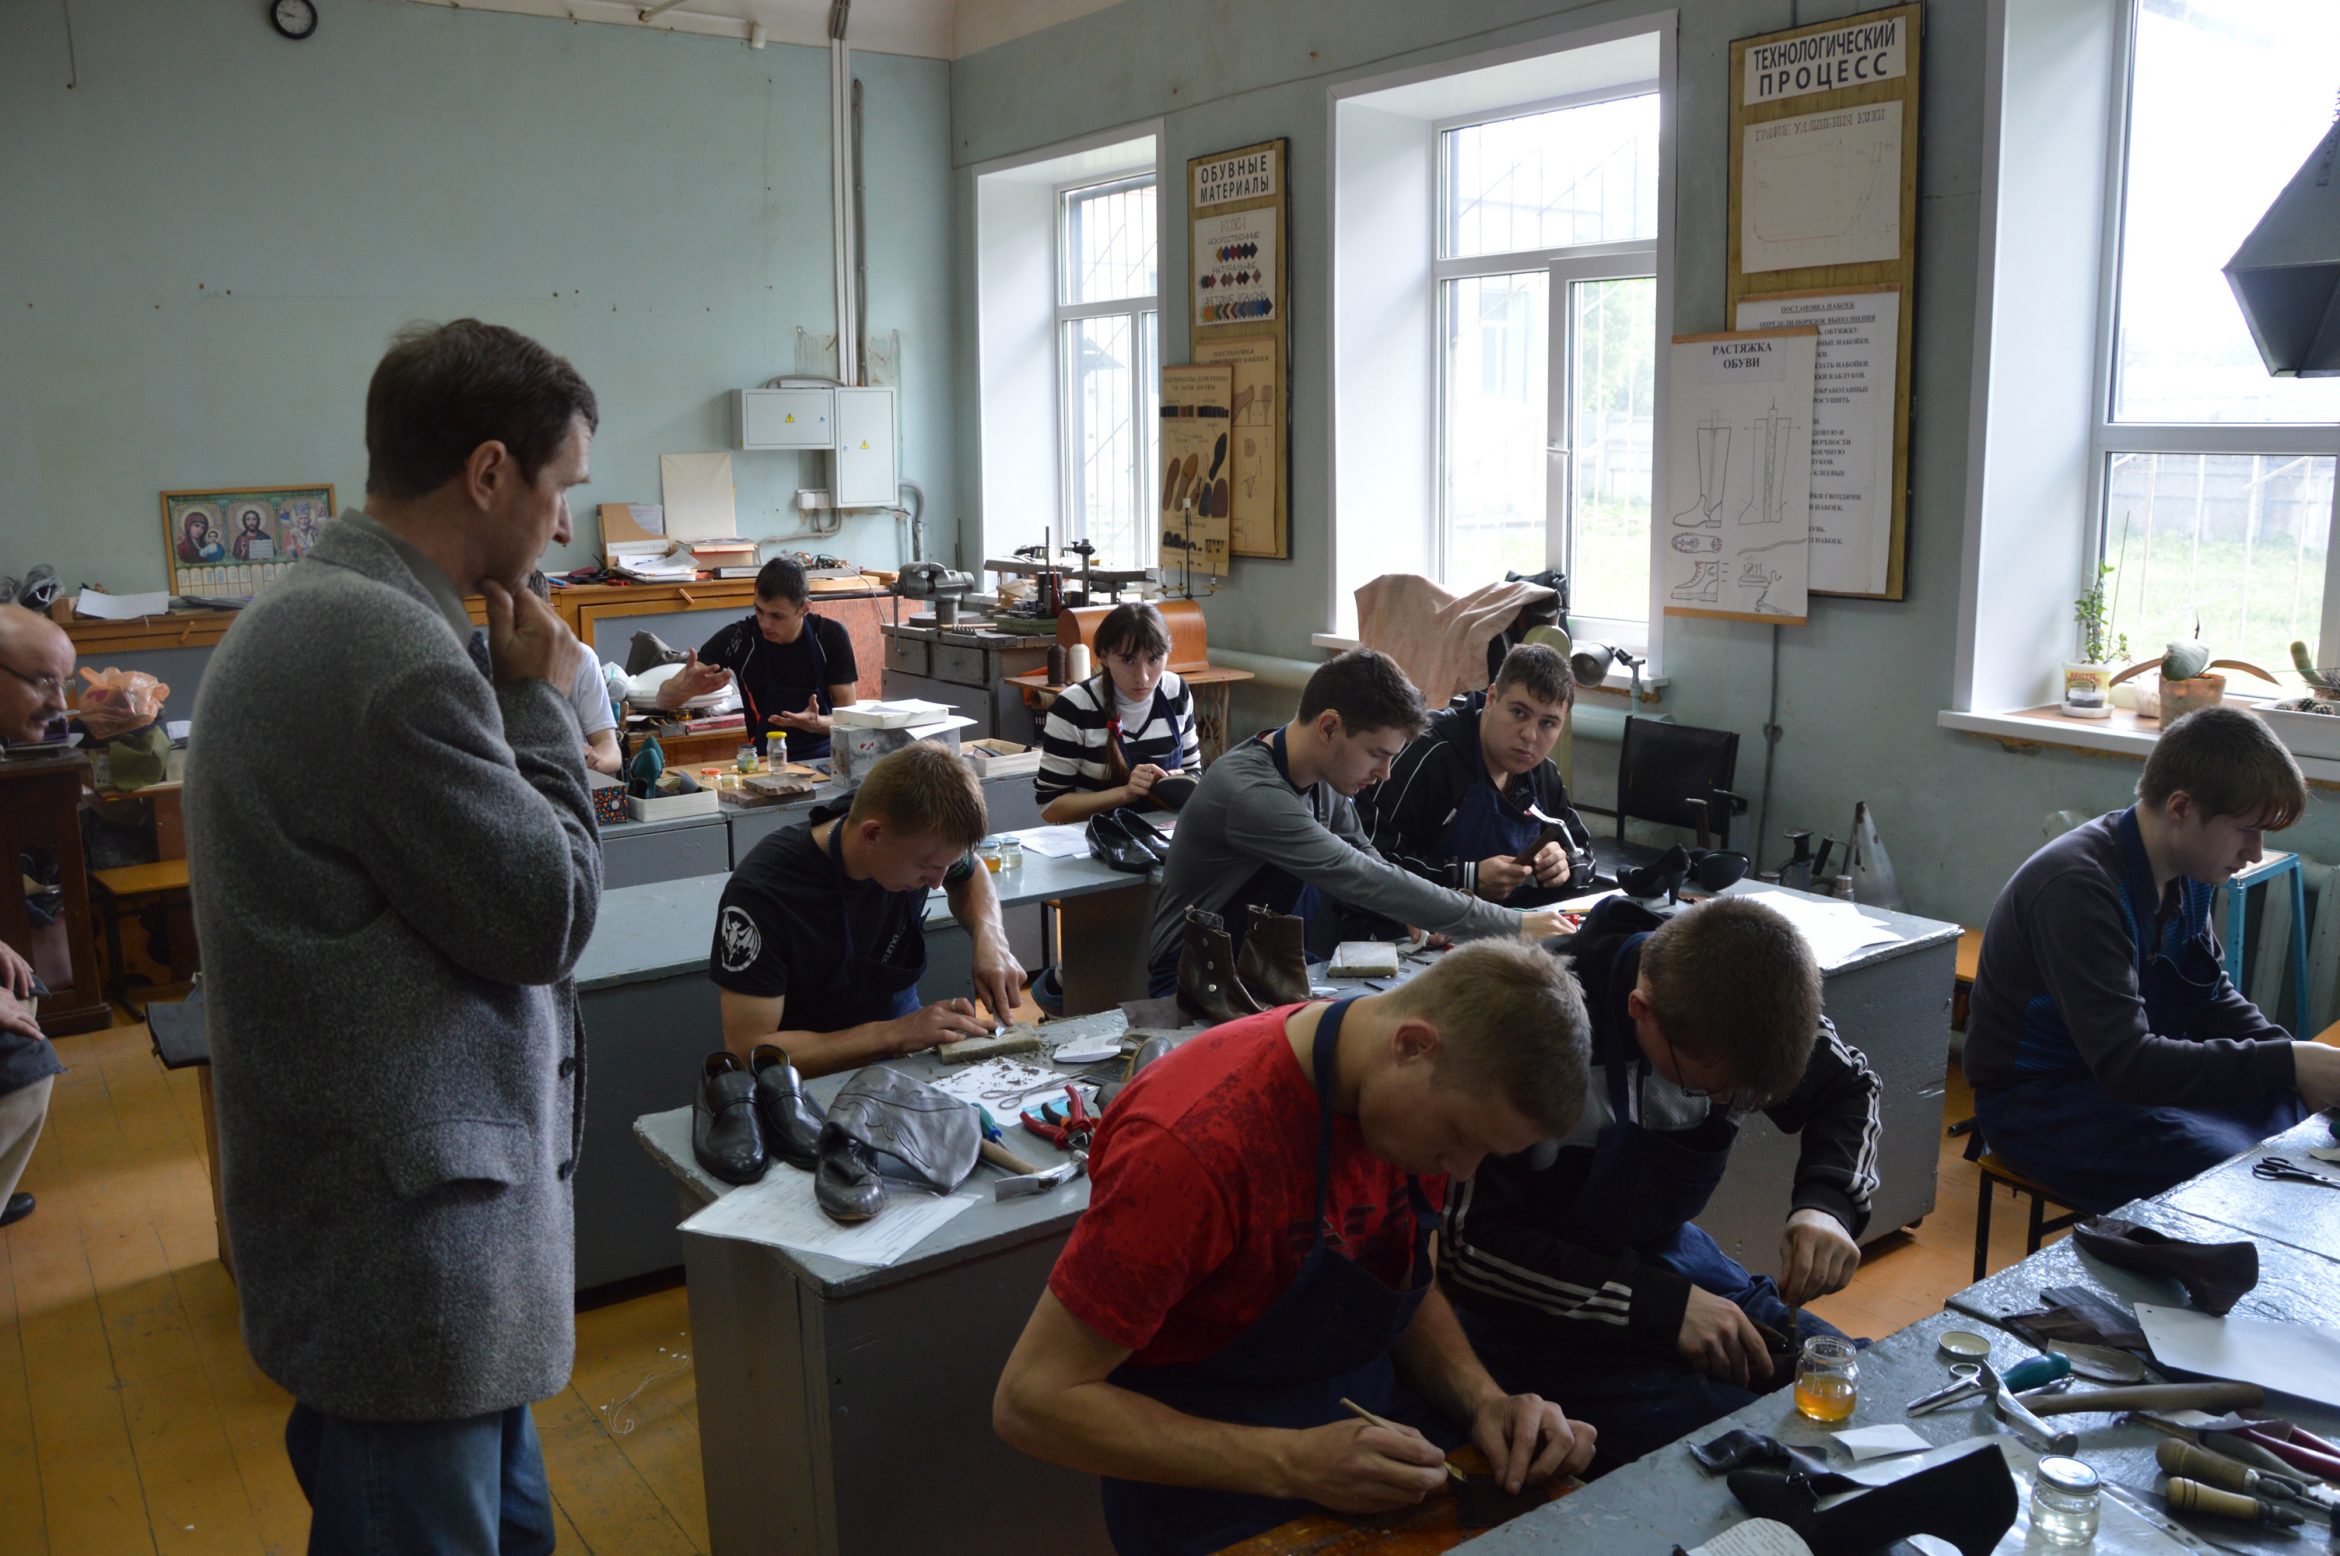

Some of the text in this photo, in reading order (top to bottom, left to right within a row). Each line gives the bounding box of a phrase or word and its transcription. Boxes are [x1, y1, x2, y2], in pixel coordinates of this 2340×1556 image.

[1754, 17, 1895, 71] ТЕХНОЛОГИЧЕСКИЙ
[1760, 52, 1888, 97] ПРОЦЕСС
[1201, 154, 1267, 184] ОБУВНЫЕ
[1200, 175, 1269, 203] МАТЕРИАЛЫ
[1712, 342, 1772, 356] РАСТЯЖКА
[1723, 357, 1760, 369] ОБУВИ
